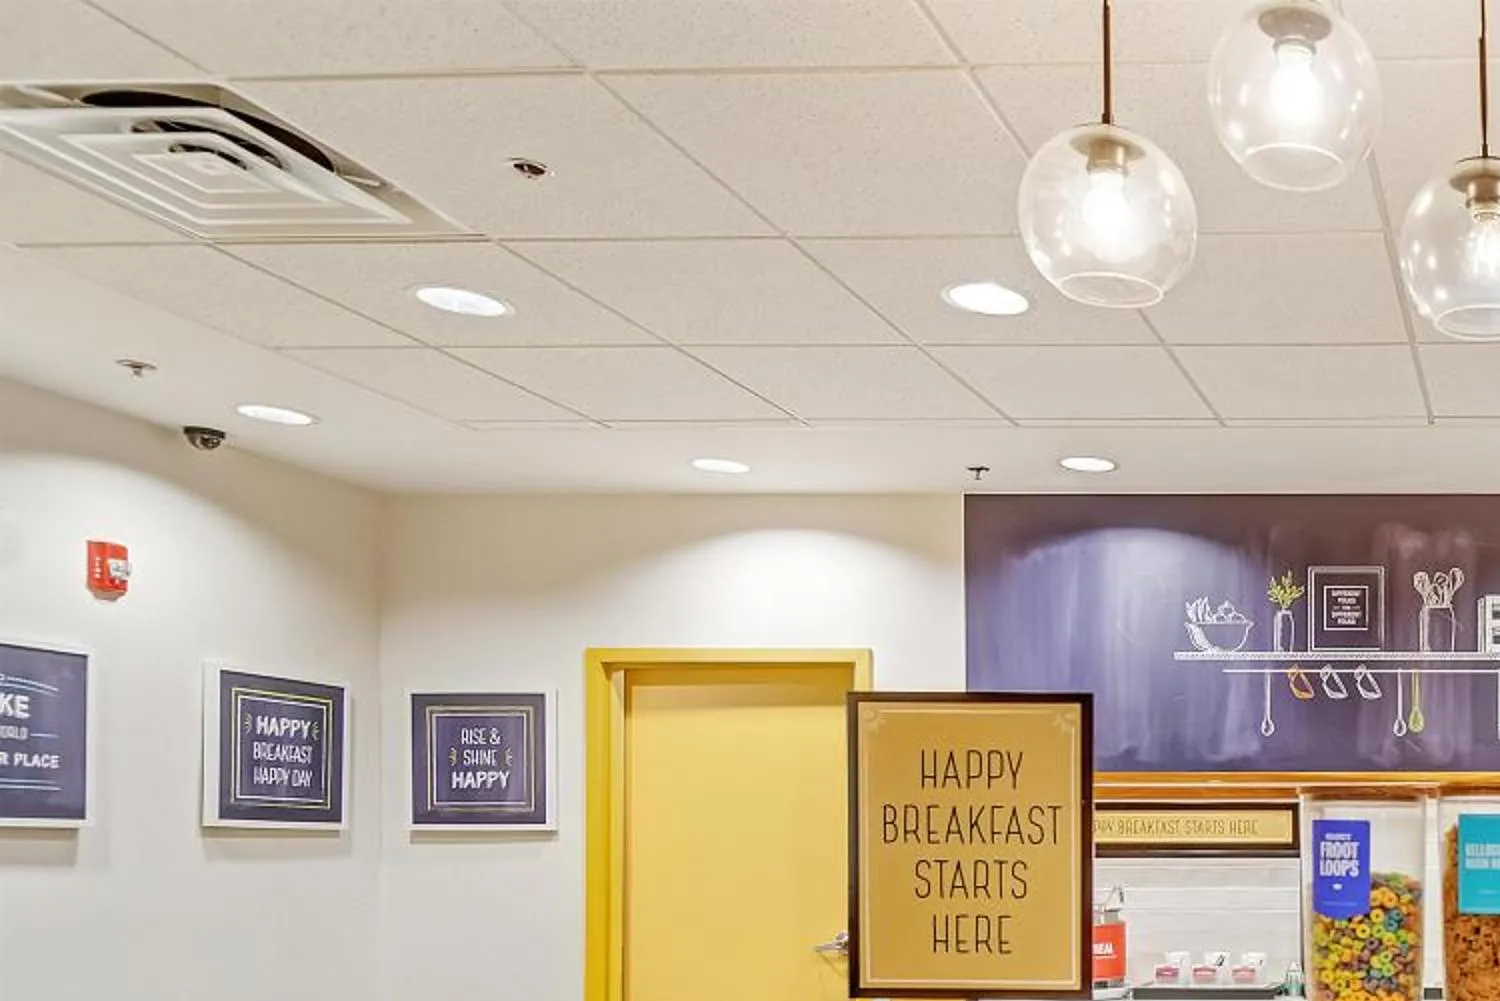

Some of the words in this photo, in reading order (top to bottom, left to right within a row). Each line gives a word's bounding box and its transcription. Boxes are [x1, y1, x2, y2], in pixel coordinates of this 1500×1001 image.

[256, 715, 311, 739] HAPPY
[461, 727, 487, 745] RISE
[489, 727, 501, 745] &
[13, 752, 61, 769] PLACE
[253, 741, 313, 764] BREAKFAST
[463, 749, 498, 767] SHINE
[253, 766, 290, 785] HAPPY
[291, 768, 313, 788] DAY
[451, 770, 510, 789] HAPPY
[921, 749, 1023, 790] HAPPY
[882, 803, 1062, 845] BREAKFAST
[1119, 819, 1180, 835] BREAKFAST
[1185, 819, 1225, 835] STARTS
[1229, 819, 1259, 835] HERE
[1320, 841, 1360, 859] FROOT
[1319, 859, 1359, 877] LOOPS
[915, 859, 1028, 900] STARTS
[932, 914, 1013, 954] HERE
